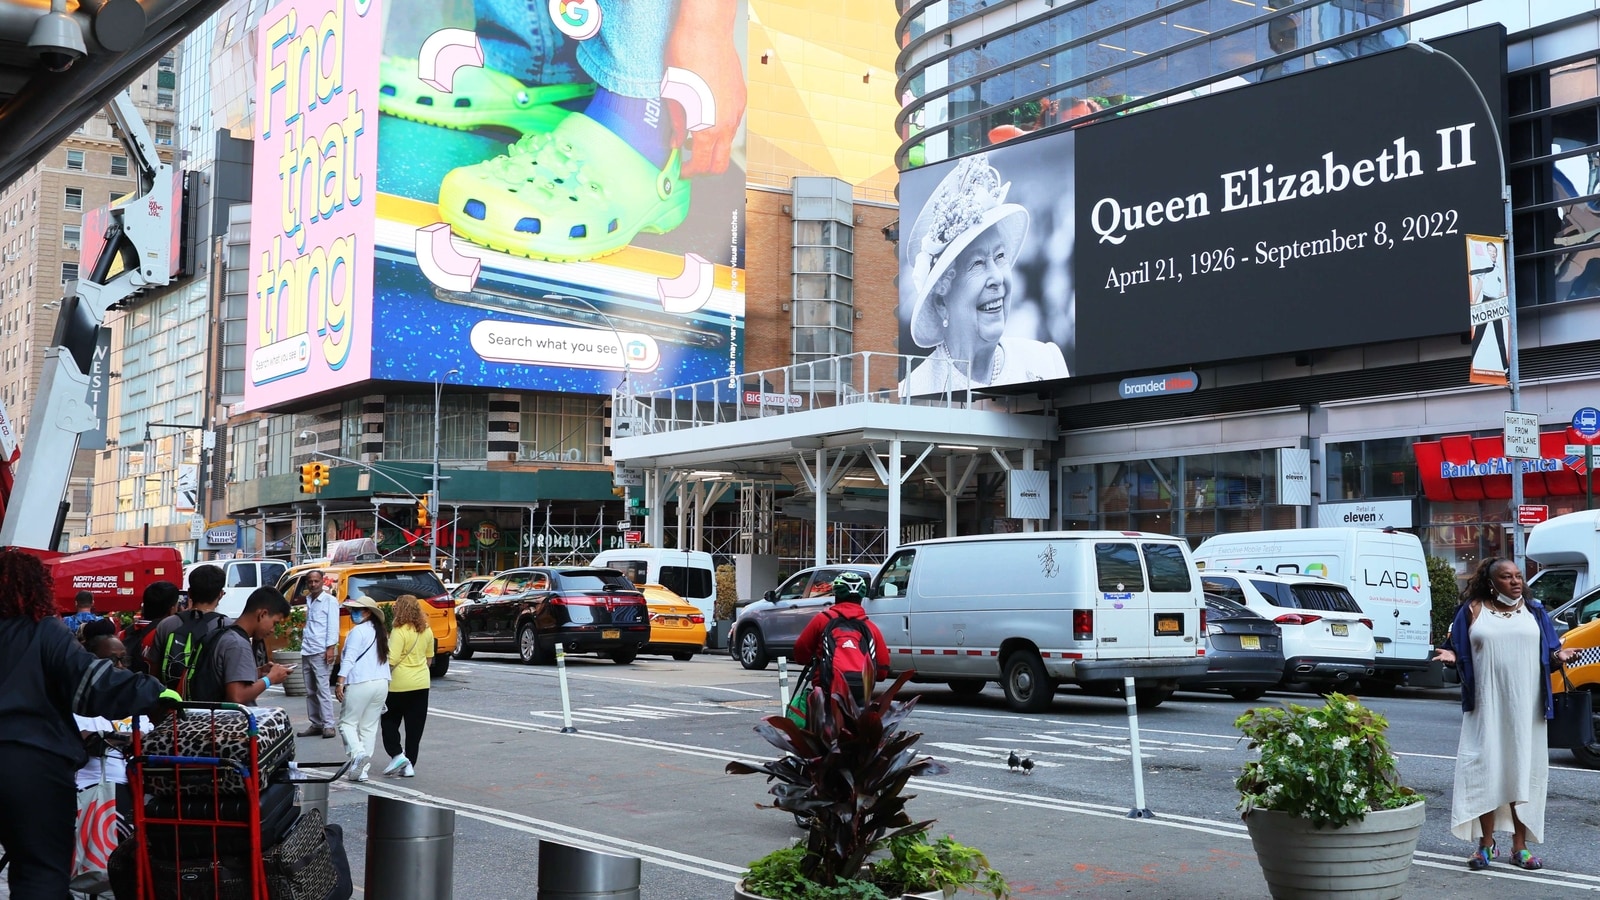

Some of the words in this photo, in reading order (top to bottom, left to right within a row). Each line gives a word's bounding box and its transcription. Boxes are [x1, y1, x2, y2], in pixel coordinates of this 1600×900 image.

[262, 0, 345, 140] Find
[279, 89, 364, 237] that
[1091, 192, 1210, 245] Queen
[1220, 136, 1424, 213] Elizabeth
[1436, 122, 1477, 172] II
[1105, 260, 1150, 293] April
[1155, 257, 1183, 283] 21,
[1191, 247, 1235, 275] 1926
[1254, 229, 1368, 268] September
[1374, 221, 1394, 250] 8,
[1402, 209, 1459, 243] 2022
[257, 222, 356, 371] thing
[1472, 304, 1510, 323] MORMON
[488, 332, 532, 348] Search
[536, 338, 567, 350] what
[571, 342, 593, 354] you
[596, 344, 618, 355] see
[764, 395, 800, 404] OUTDOR
[1507, 416, 1519, 425] RIGHT
[1521, 418, 1536, 426] TURNS
[1507, 435, 1521, 443] RIGHT
[1523, 437, 1537, 445] LANE
[1441, 459, 1476, 478] Bank
[1479, 457, 1494, 476] of
[1343, 512, 1376, 522] eleven
[208, 530, 236, 538] Auntie
[474, 528, 501, 540] villa
[1262, 545, 1281, 553] Testing
[1364, 568, 1421, 593] LABQ
